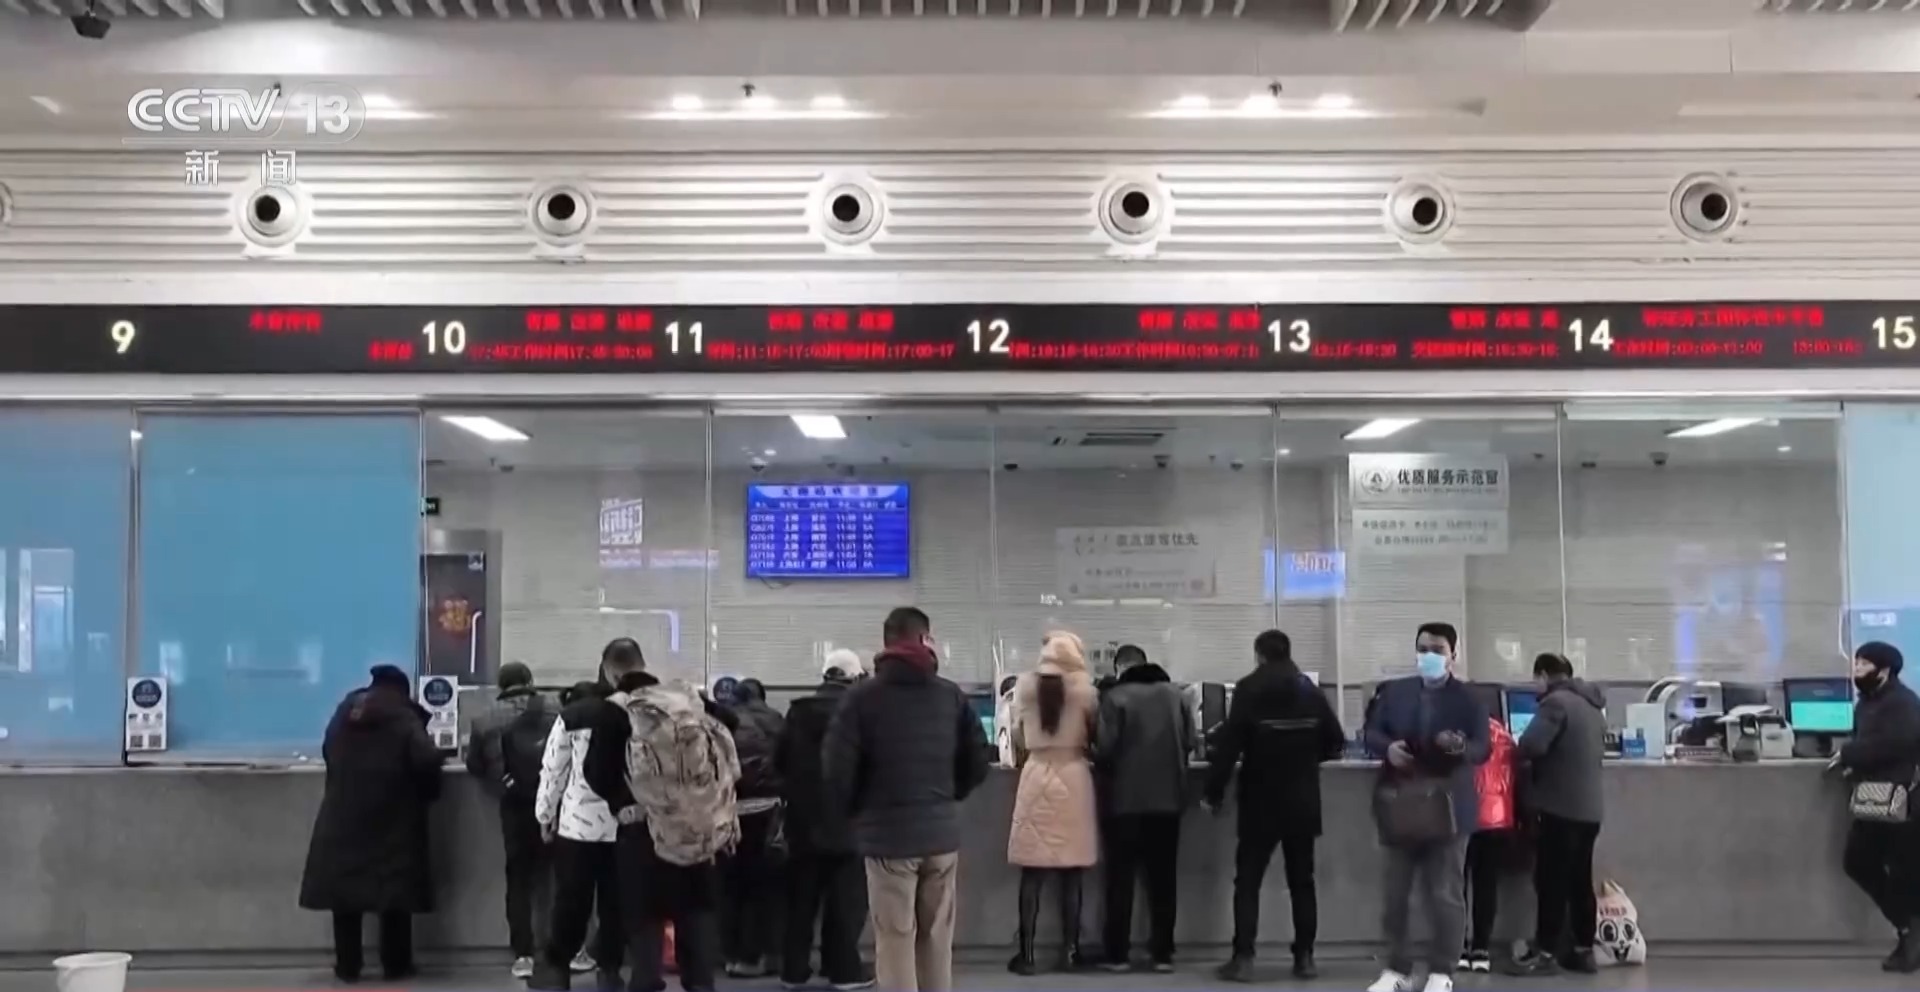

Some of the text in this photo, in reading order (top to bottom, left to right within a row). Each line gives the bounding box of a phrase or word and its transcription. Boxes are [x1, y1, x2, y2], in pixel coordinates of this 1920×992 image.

[111, 320, 136, 354] 9
[422, 320, 466, 355] 10
[665, 321, 703, 354] 11
[967, 318, 1009, 353] 12
[1267, 320, 1311, 353] 13
[1568, 318, 1613, 352] 14
[1872, 315, 1917, 349] 15
